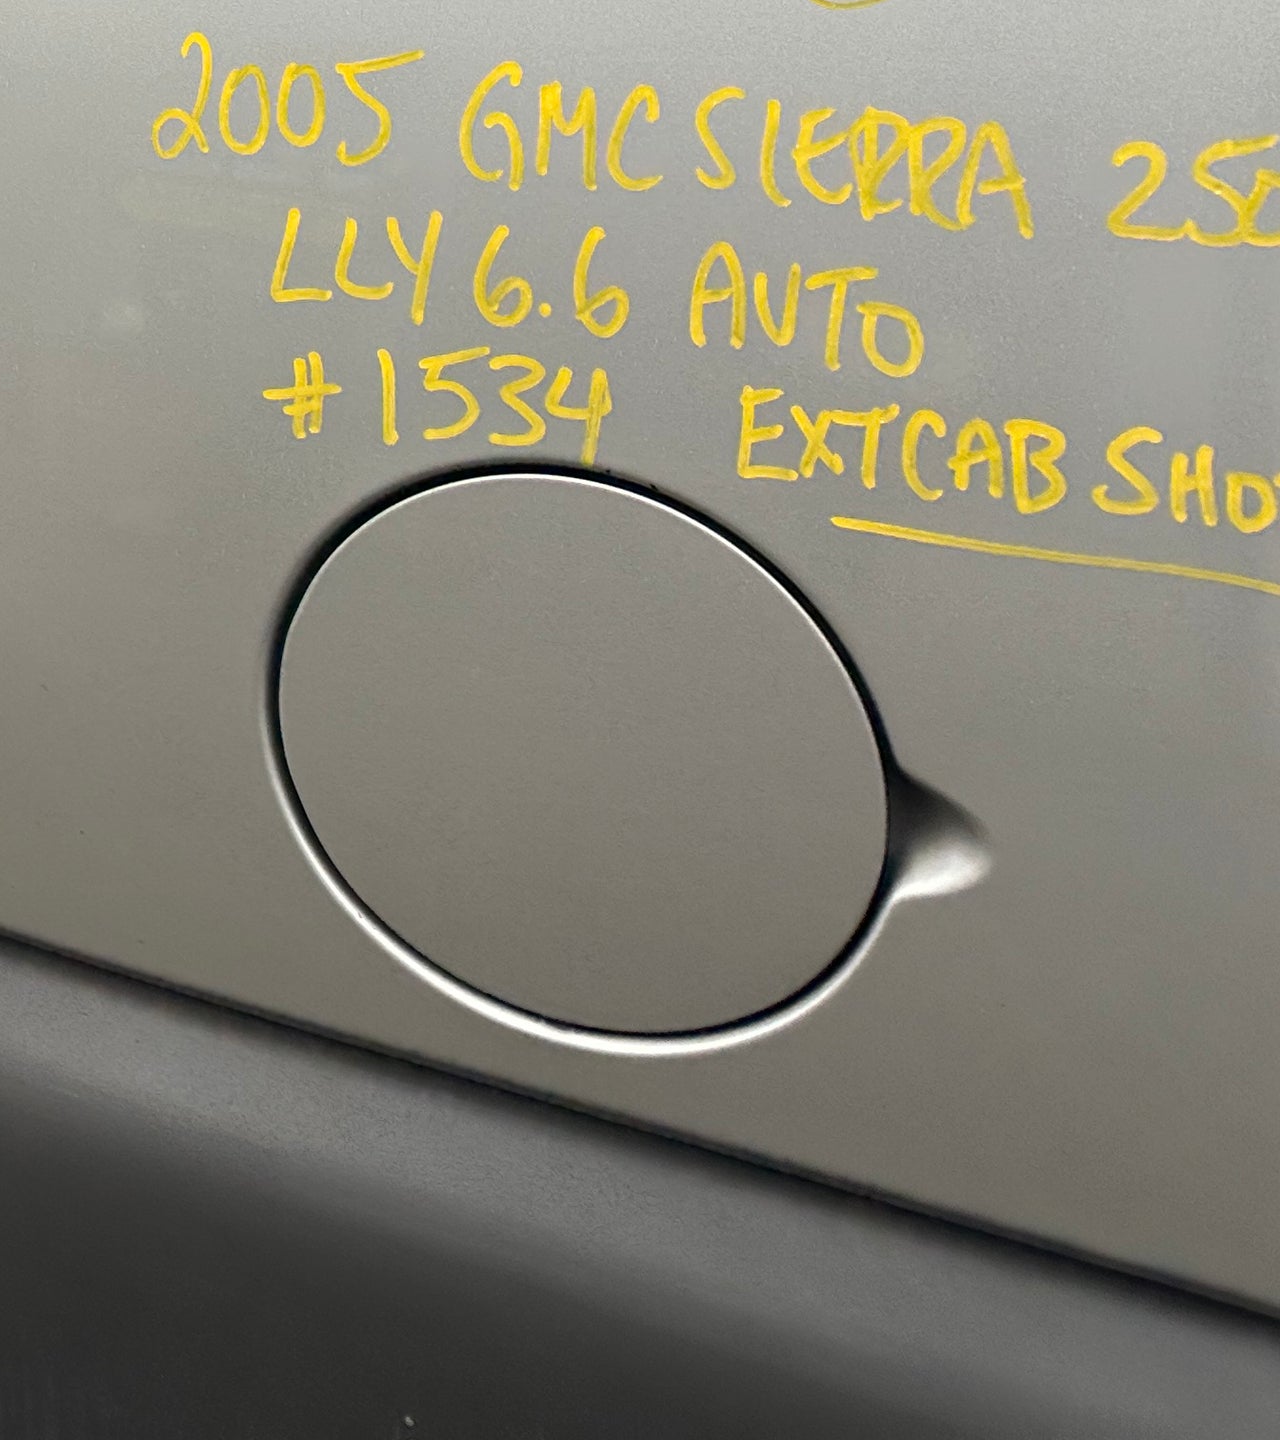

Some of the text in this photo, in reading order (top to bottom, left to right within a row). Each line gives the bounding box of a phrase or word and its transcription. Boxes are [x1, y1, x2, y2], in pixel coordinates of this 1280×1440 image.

[151, 31, 426, 166] 2005
[458, 60, 664, 191] GMC
[694, 85, 1035, 240] SIERRA
[269, 206, 926, 378] LLY 6.6 AUTO
[262, 348, 613, 467] #1534
[1091, 425, 1280, 534] SHO
